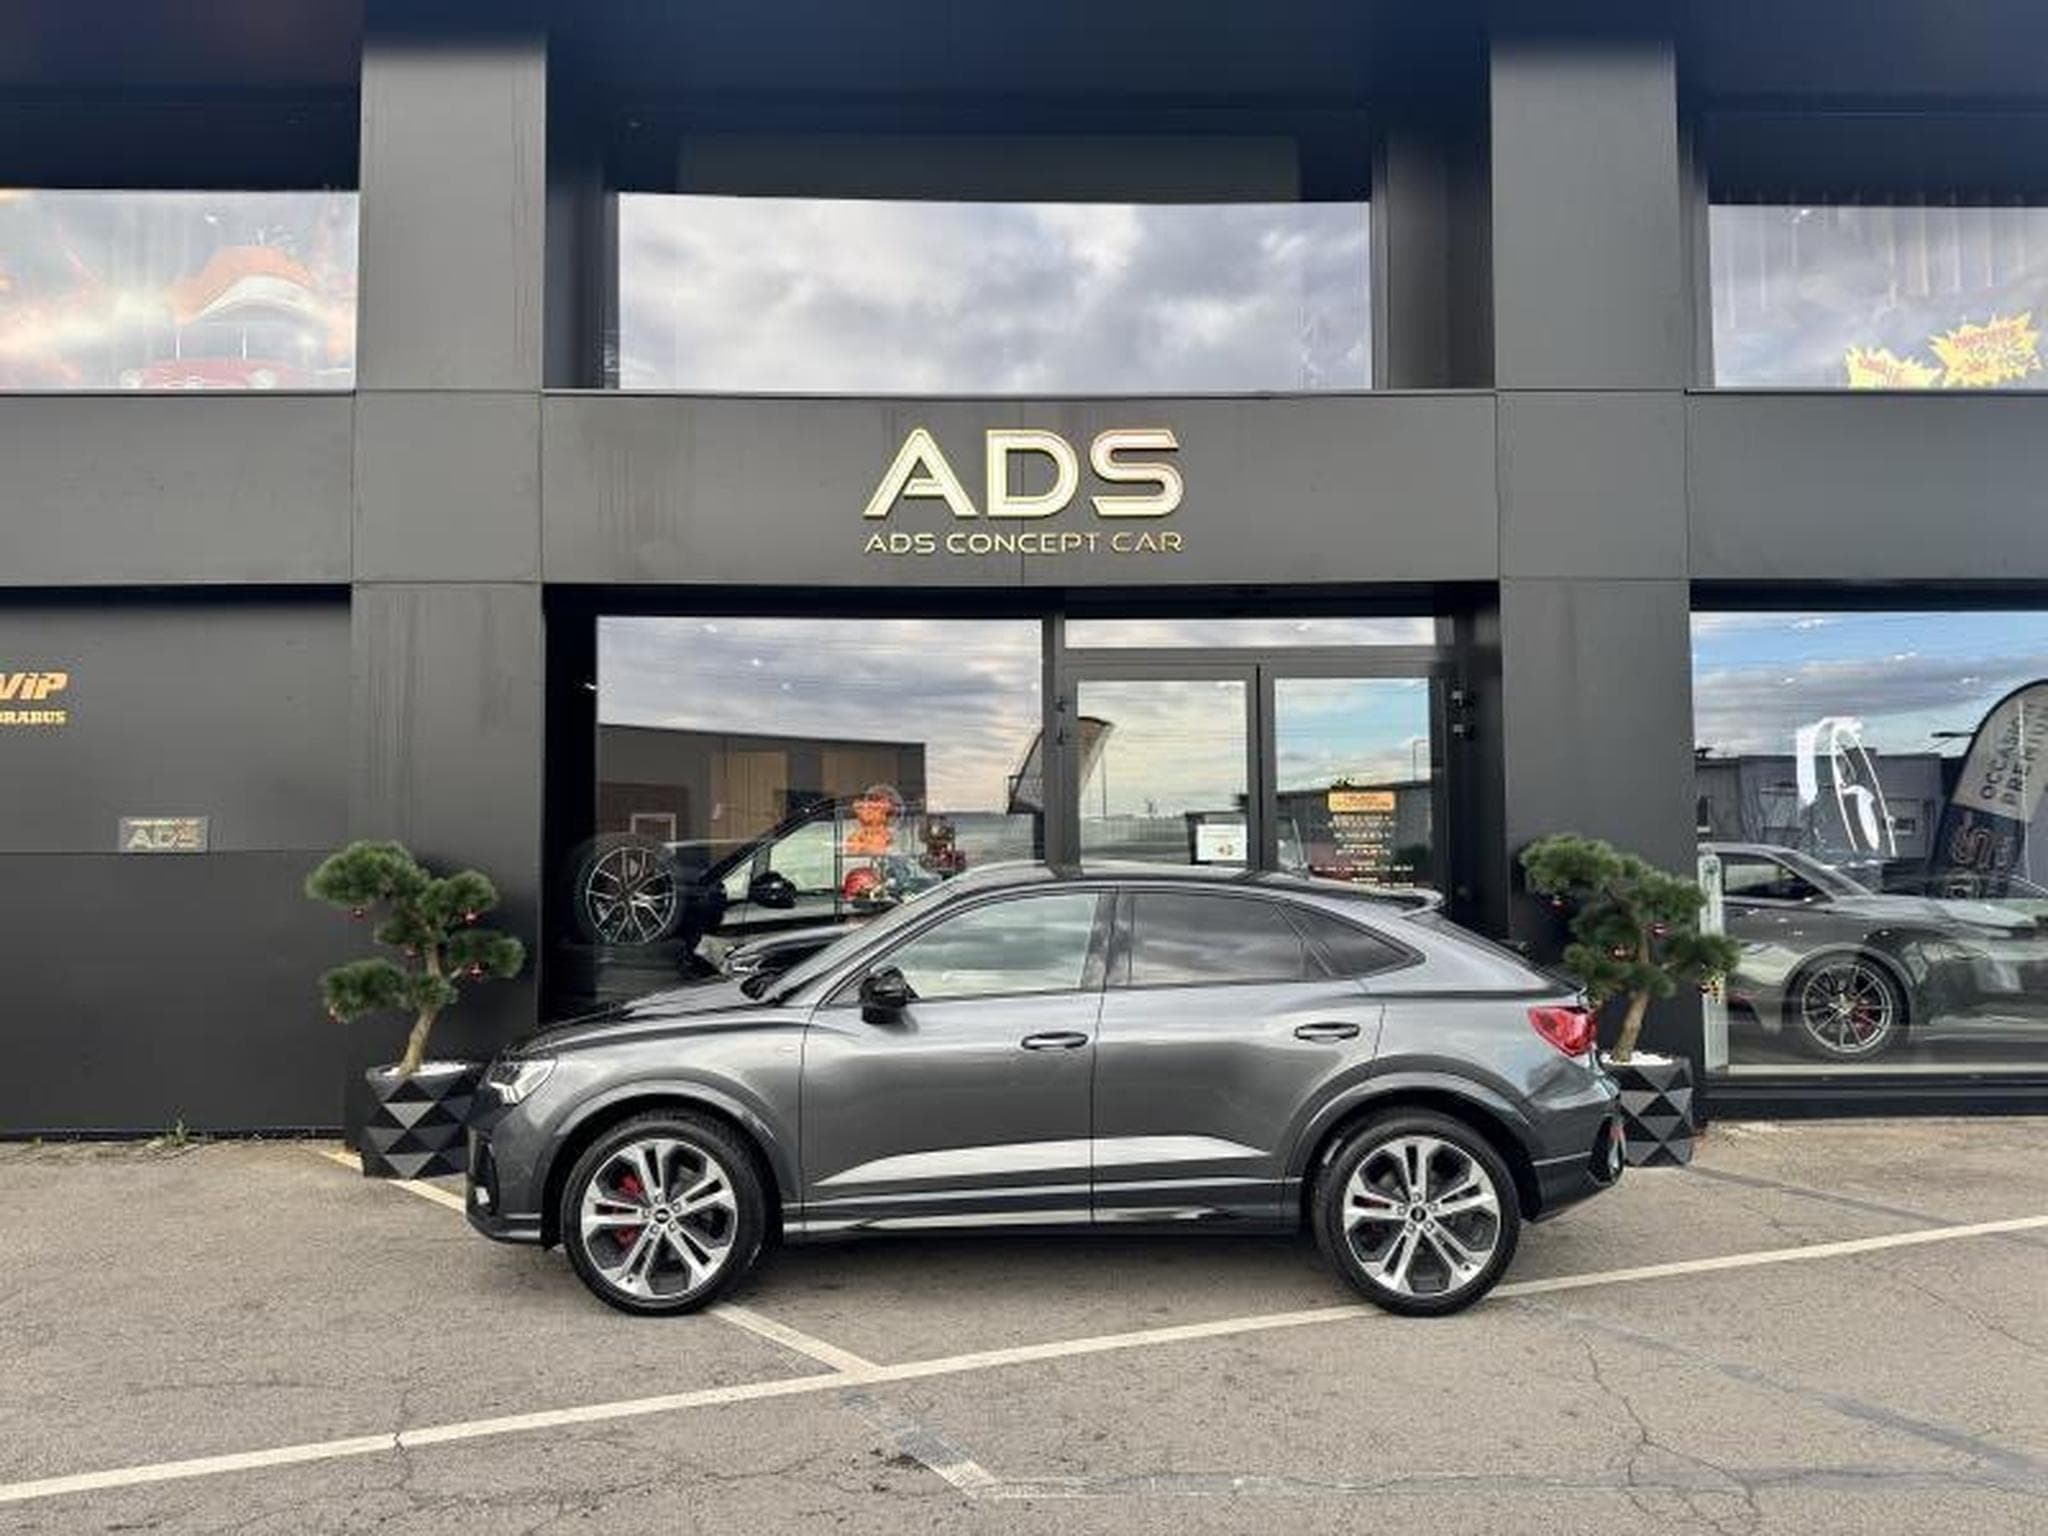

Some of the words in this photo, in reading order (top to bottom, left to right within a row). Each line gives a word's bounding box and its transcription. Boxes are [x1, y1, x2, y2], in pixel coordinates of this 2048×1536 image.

[863, 429, 1184, 518] ADS
[864, 533, 936, 554] ADS
[946, 532, 1099, 554] CONCEPT
[1111, 531, 1184, 554] CAR
[0, 710, 66, 725] RABUS
